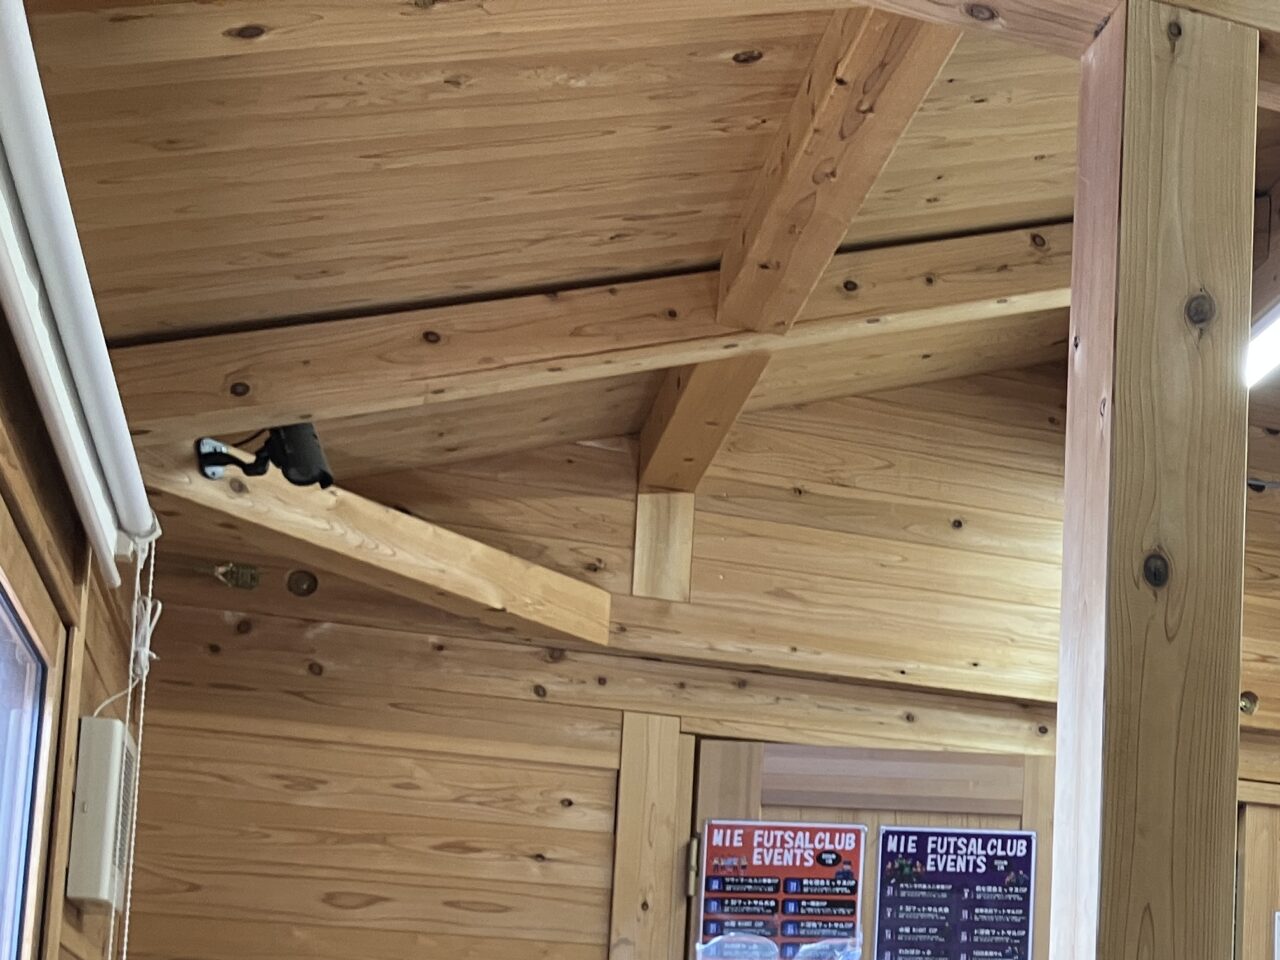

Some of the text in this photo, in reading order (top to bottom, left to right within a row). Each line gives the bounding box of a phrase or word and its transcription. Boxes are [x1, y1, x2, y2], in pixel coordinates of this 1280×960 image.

[753, 830, 856, 850] FUTSALCLUB
[927, 836, 1027, 856] FUTSALCLUB
[752, 848, 814, 866] EVENTS
[926, 854, 987, 873] EVENTS
